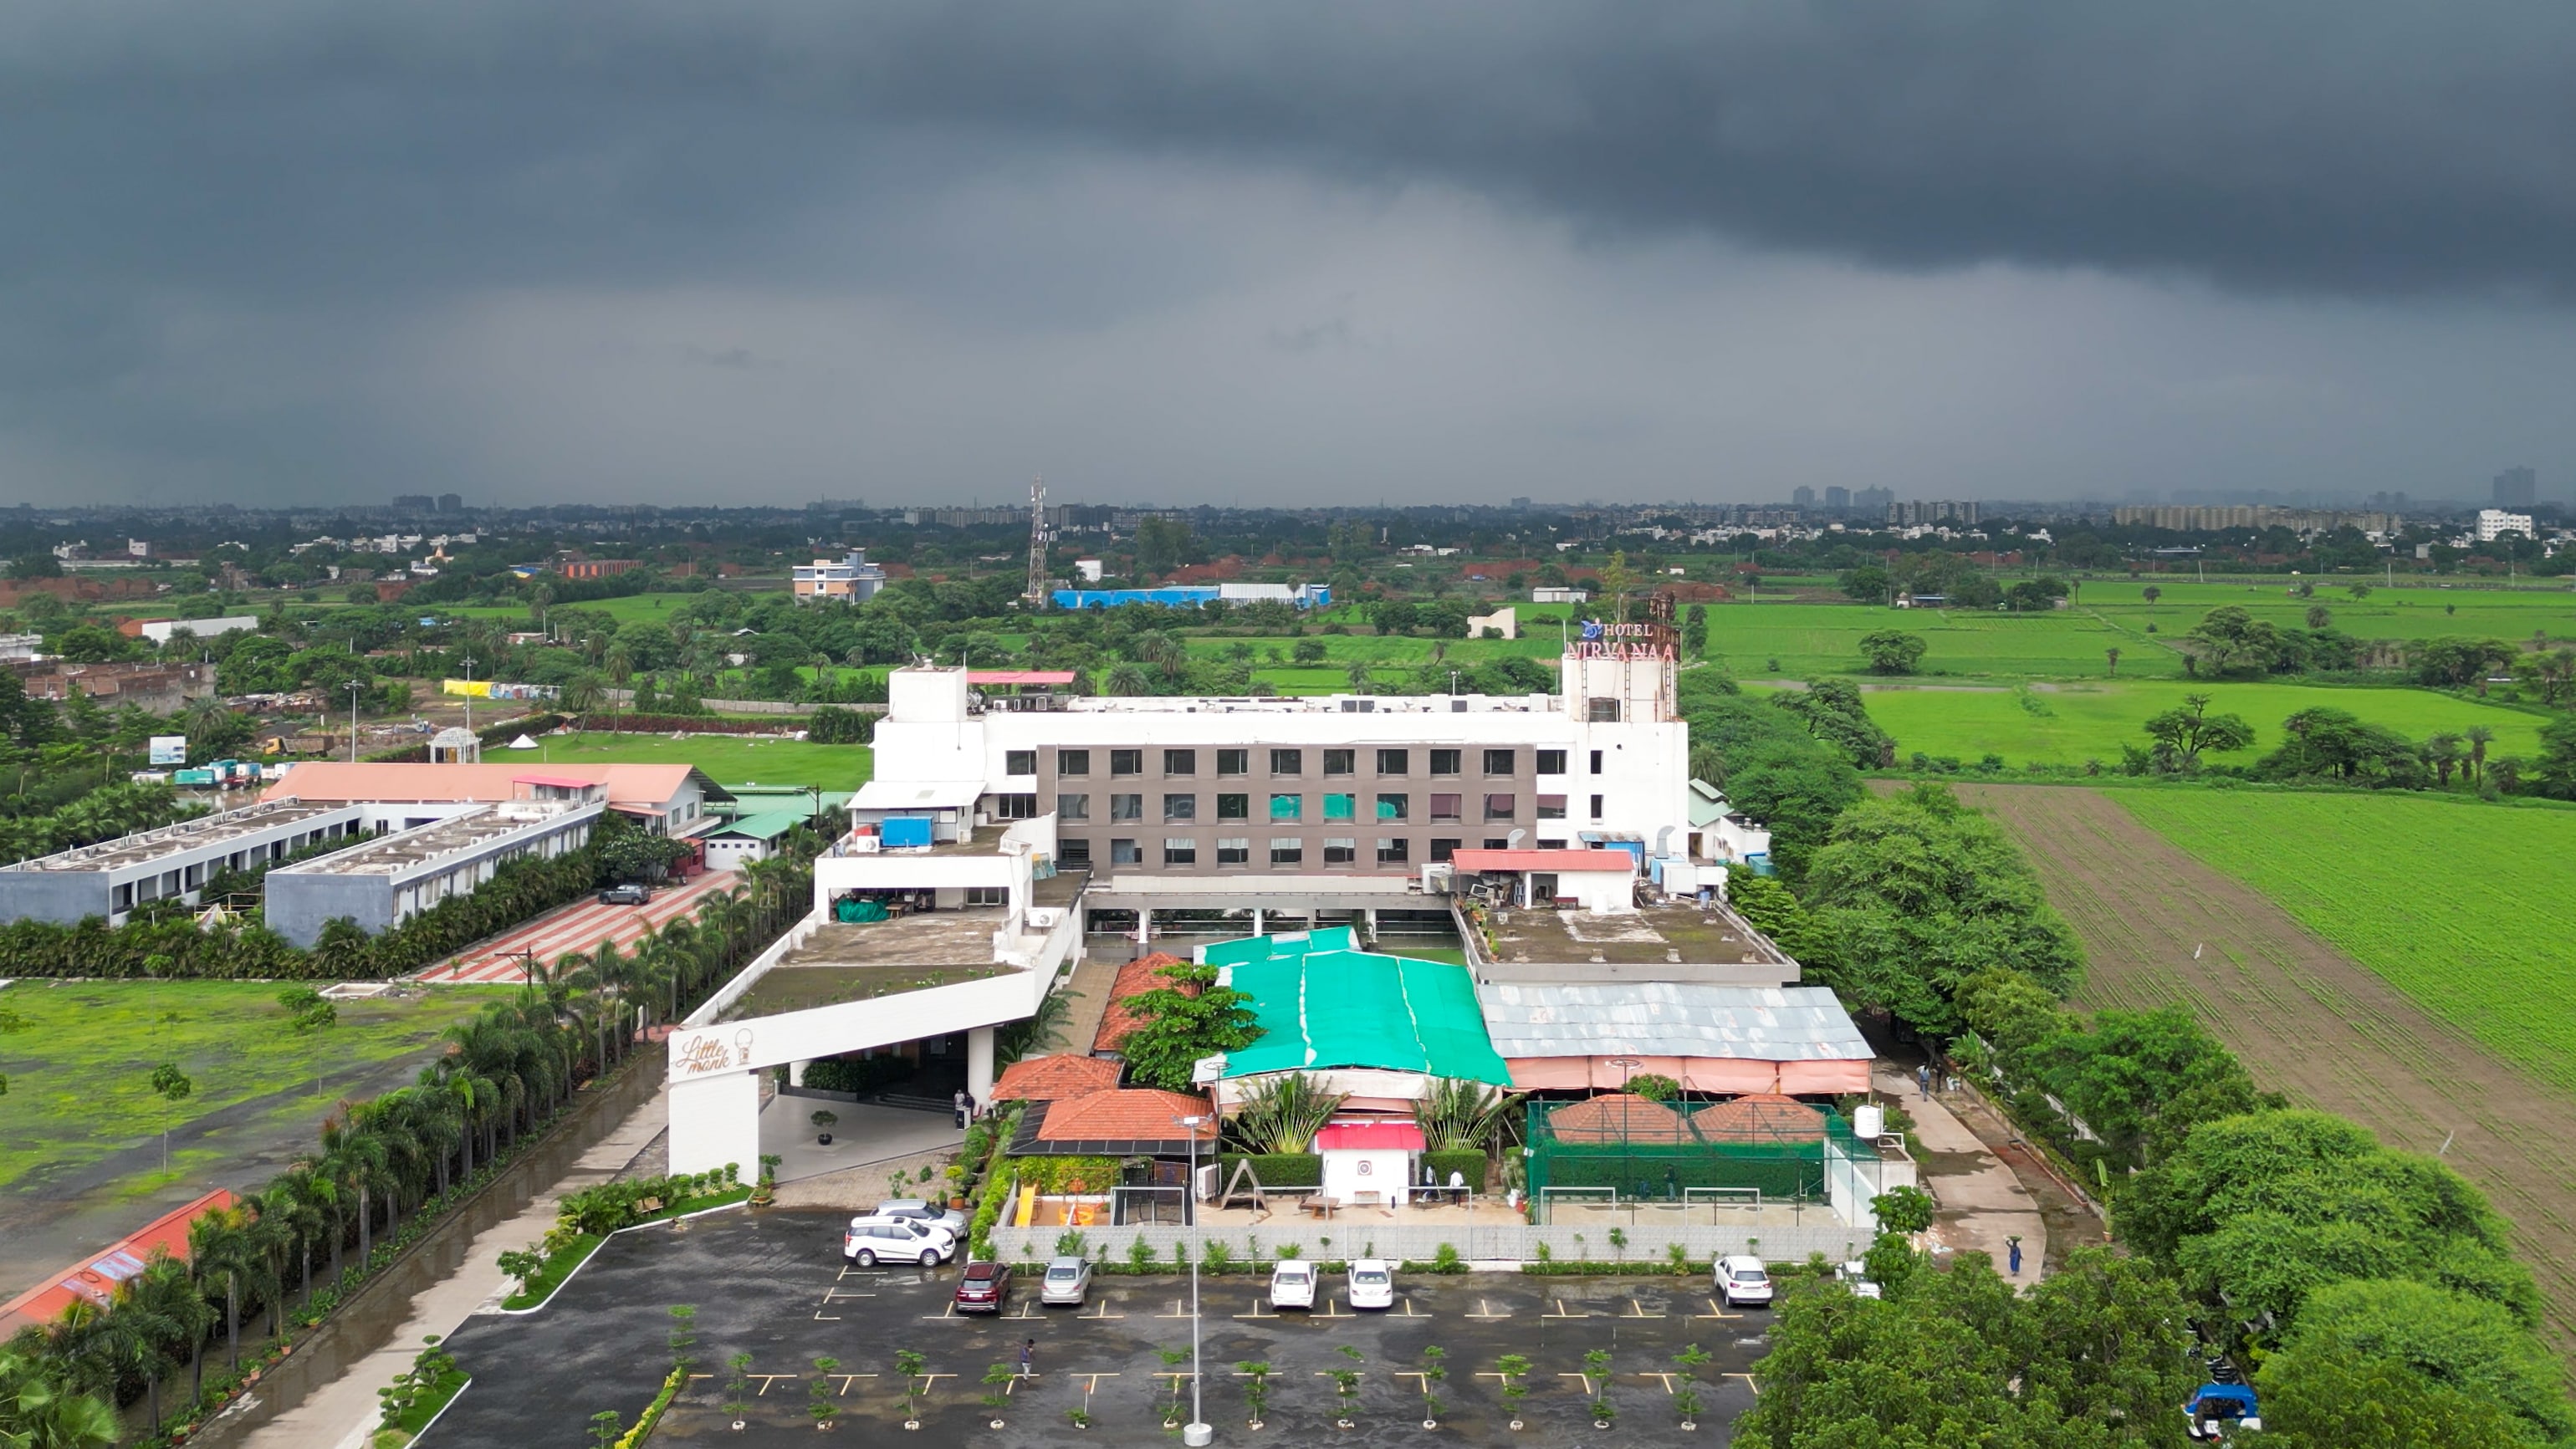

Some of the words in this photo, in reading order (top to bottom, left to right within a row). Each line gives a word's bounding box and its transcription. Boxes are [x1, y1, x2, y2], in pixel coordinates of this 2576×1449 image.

[1604, 623, 1653, 637] HOTEL
[1567, 641, 1674, 662] NIRVANAA
[676, 1035, 725, 1068] Little
